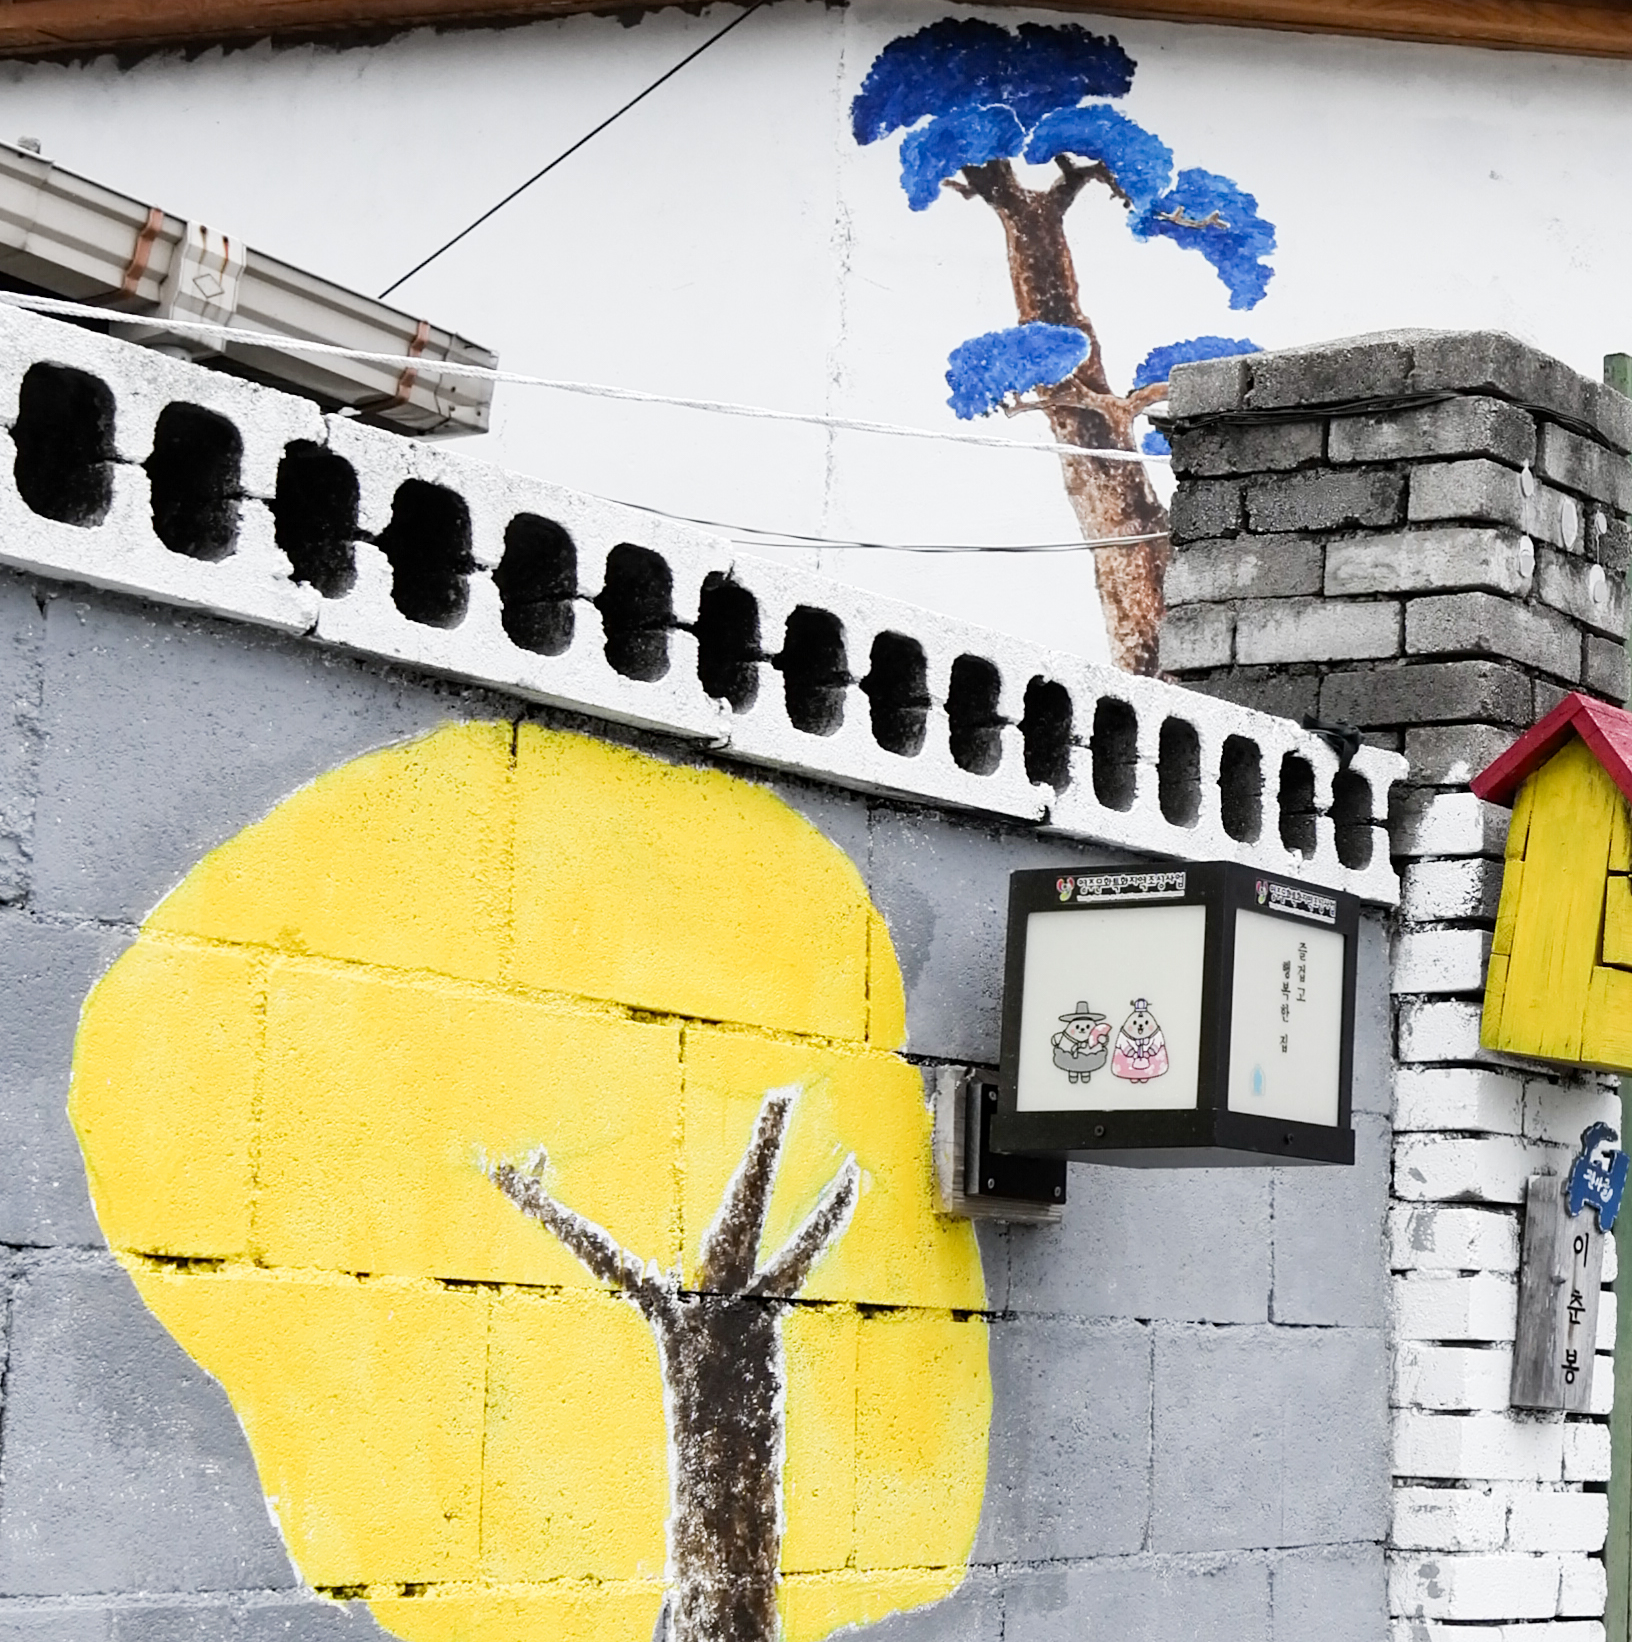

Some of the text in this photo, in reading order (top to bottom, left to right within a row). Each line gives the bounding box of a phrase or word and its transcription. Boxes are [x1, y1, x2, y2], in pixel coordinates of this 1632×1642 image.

[1280, 960, 1291, 1054] 행복한 집
[1296, 942, 1308, 1002] 즐겁고
[1561, 1232, 1590, 1385] 이춘봉
